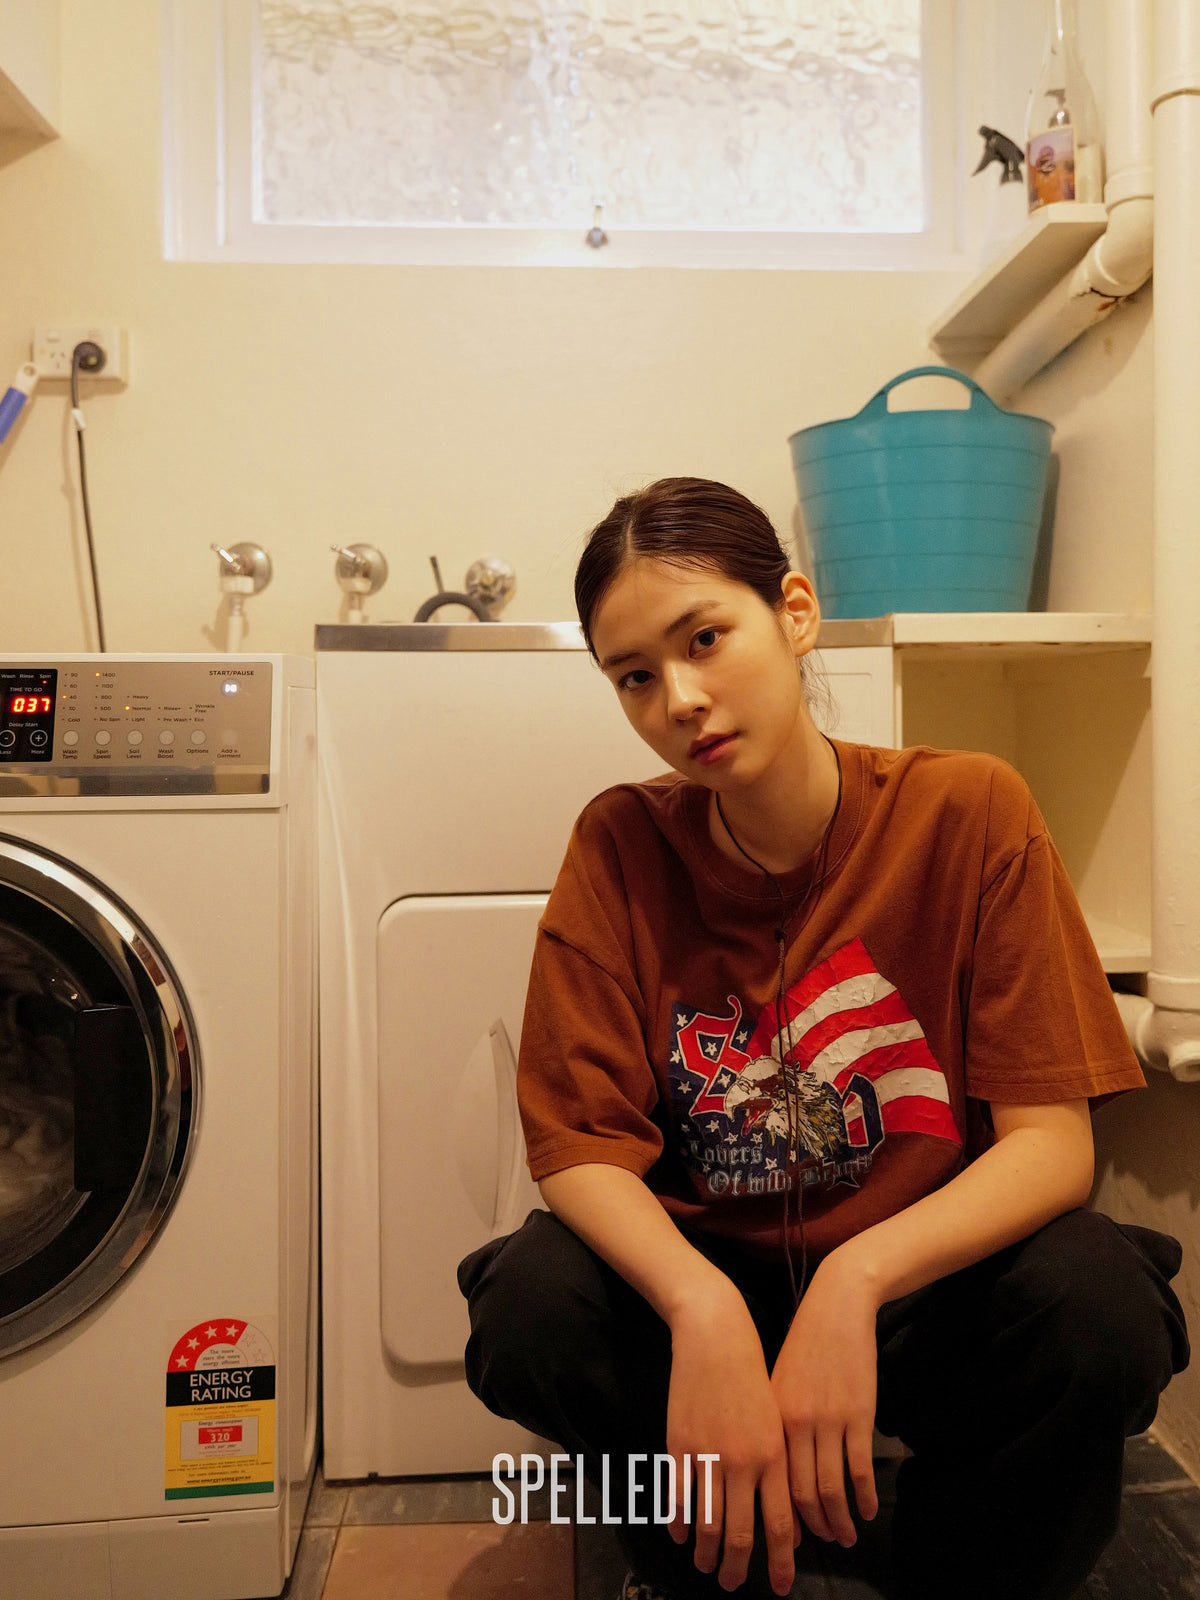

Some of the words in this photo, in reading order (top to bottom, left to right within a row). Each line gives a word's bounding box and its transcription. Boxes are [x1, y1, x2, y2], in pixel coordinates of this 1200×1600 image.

[13, 697, 51, 713] 037
[706, 1168, 744, 1196] Of
[189, 1370, 253, 1387] ENERGY
[191, 1386, 251, 1402] RATING
[210, 1432, 230, 1442] 320
